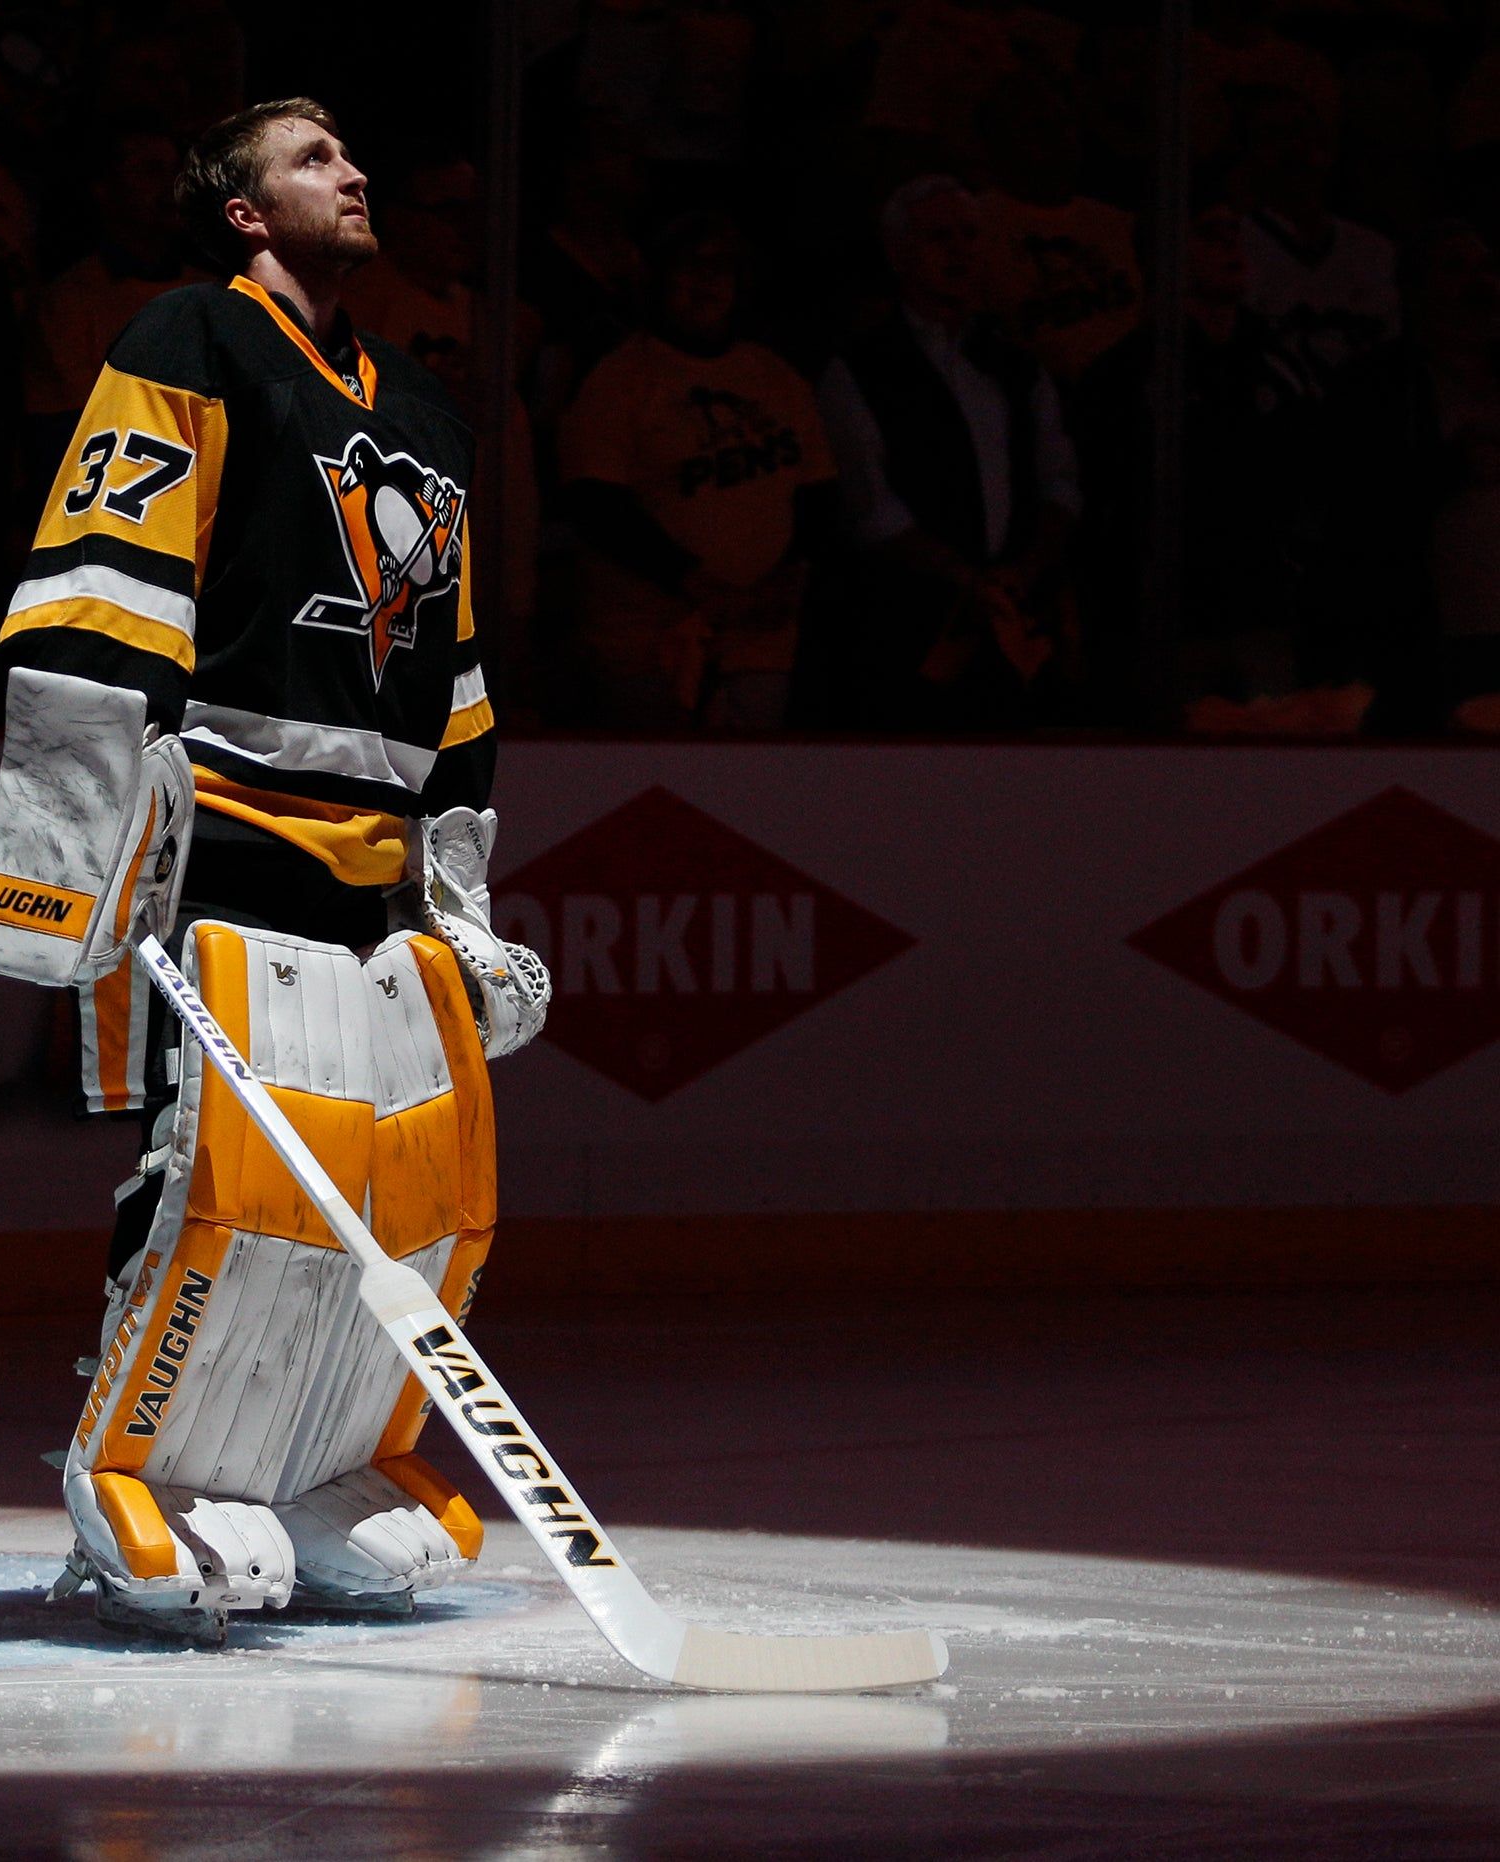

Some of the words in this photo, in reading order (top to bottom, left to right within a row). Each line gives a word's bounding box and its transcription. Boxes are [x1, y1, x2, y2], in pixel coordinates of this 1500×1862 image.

[63, 427, 197, 525] 37
[678, 427, 801, 498] PENS
[1212, 888, 1500, 989] ORKI
[155, 953, 255, 1081] VAUGHN
[124, 1267, 216, 1437] VAUGHN
[412, 1325, 619, 1568] VAUGHN
